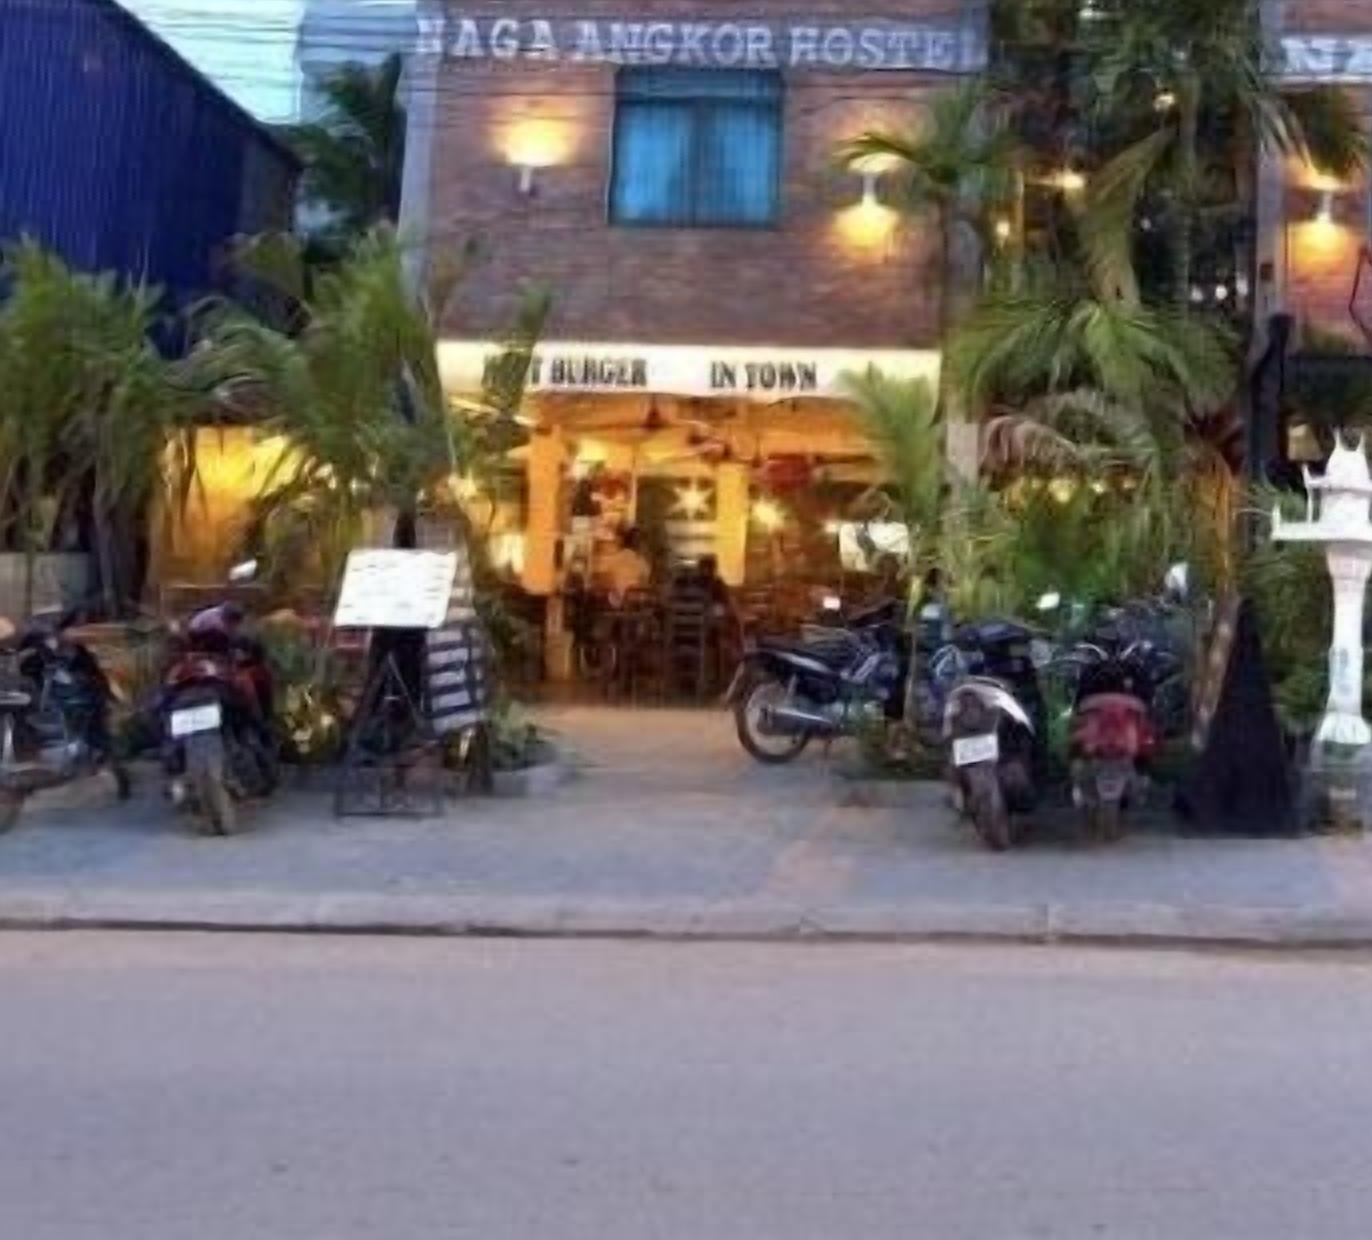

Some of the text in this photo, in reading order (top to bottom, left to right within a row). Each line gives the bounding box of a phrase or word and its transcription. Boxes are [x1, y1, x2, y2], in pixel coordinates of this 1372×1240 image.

[415, 18, 562, 60] NAGA
[567, 20, 777, 68] ANGKOR
[551, 355, 648, 387] BURGER
[710, 360, 737, 389] IN
[744, 360, 818, 391] TOWN
